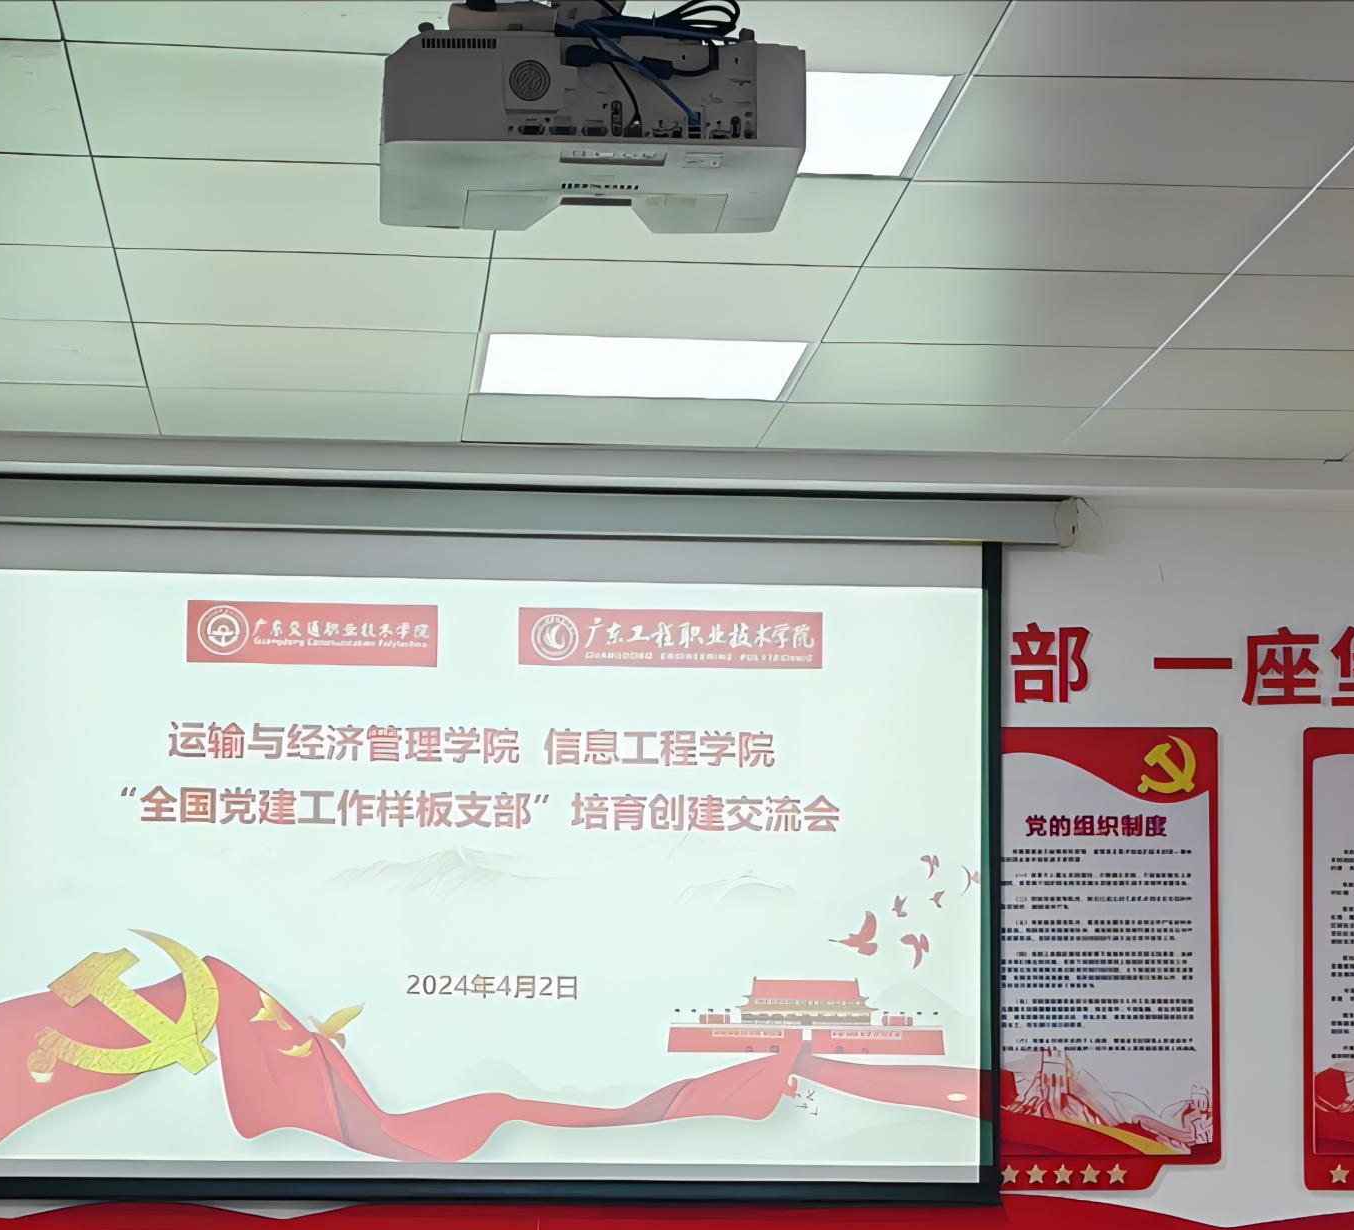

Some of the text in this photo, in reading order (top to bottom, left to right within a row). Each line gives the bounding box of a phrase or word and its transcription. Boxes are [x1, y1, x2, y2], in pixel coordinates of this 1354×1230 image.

[584, 617, 815, 649] 广东工程职业技术学院
[1010, 621, 1091, 705] 部
[168, 721, 776, 768] 运输与经济管理学院 信息工程学院
[1025, 813, 1168, 838] 党的组织制度
[406, 974, 578, 1000] 2024年4月2日
